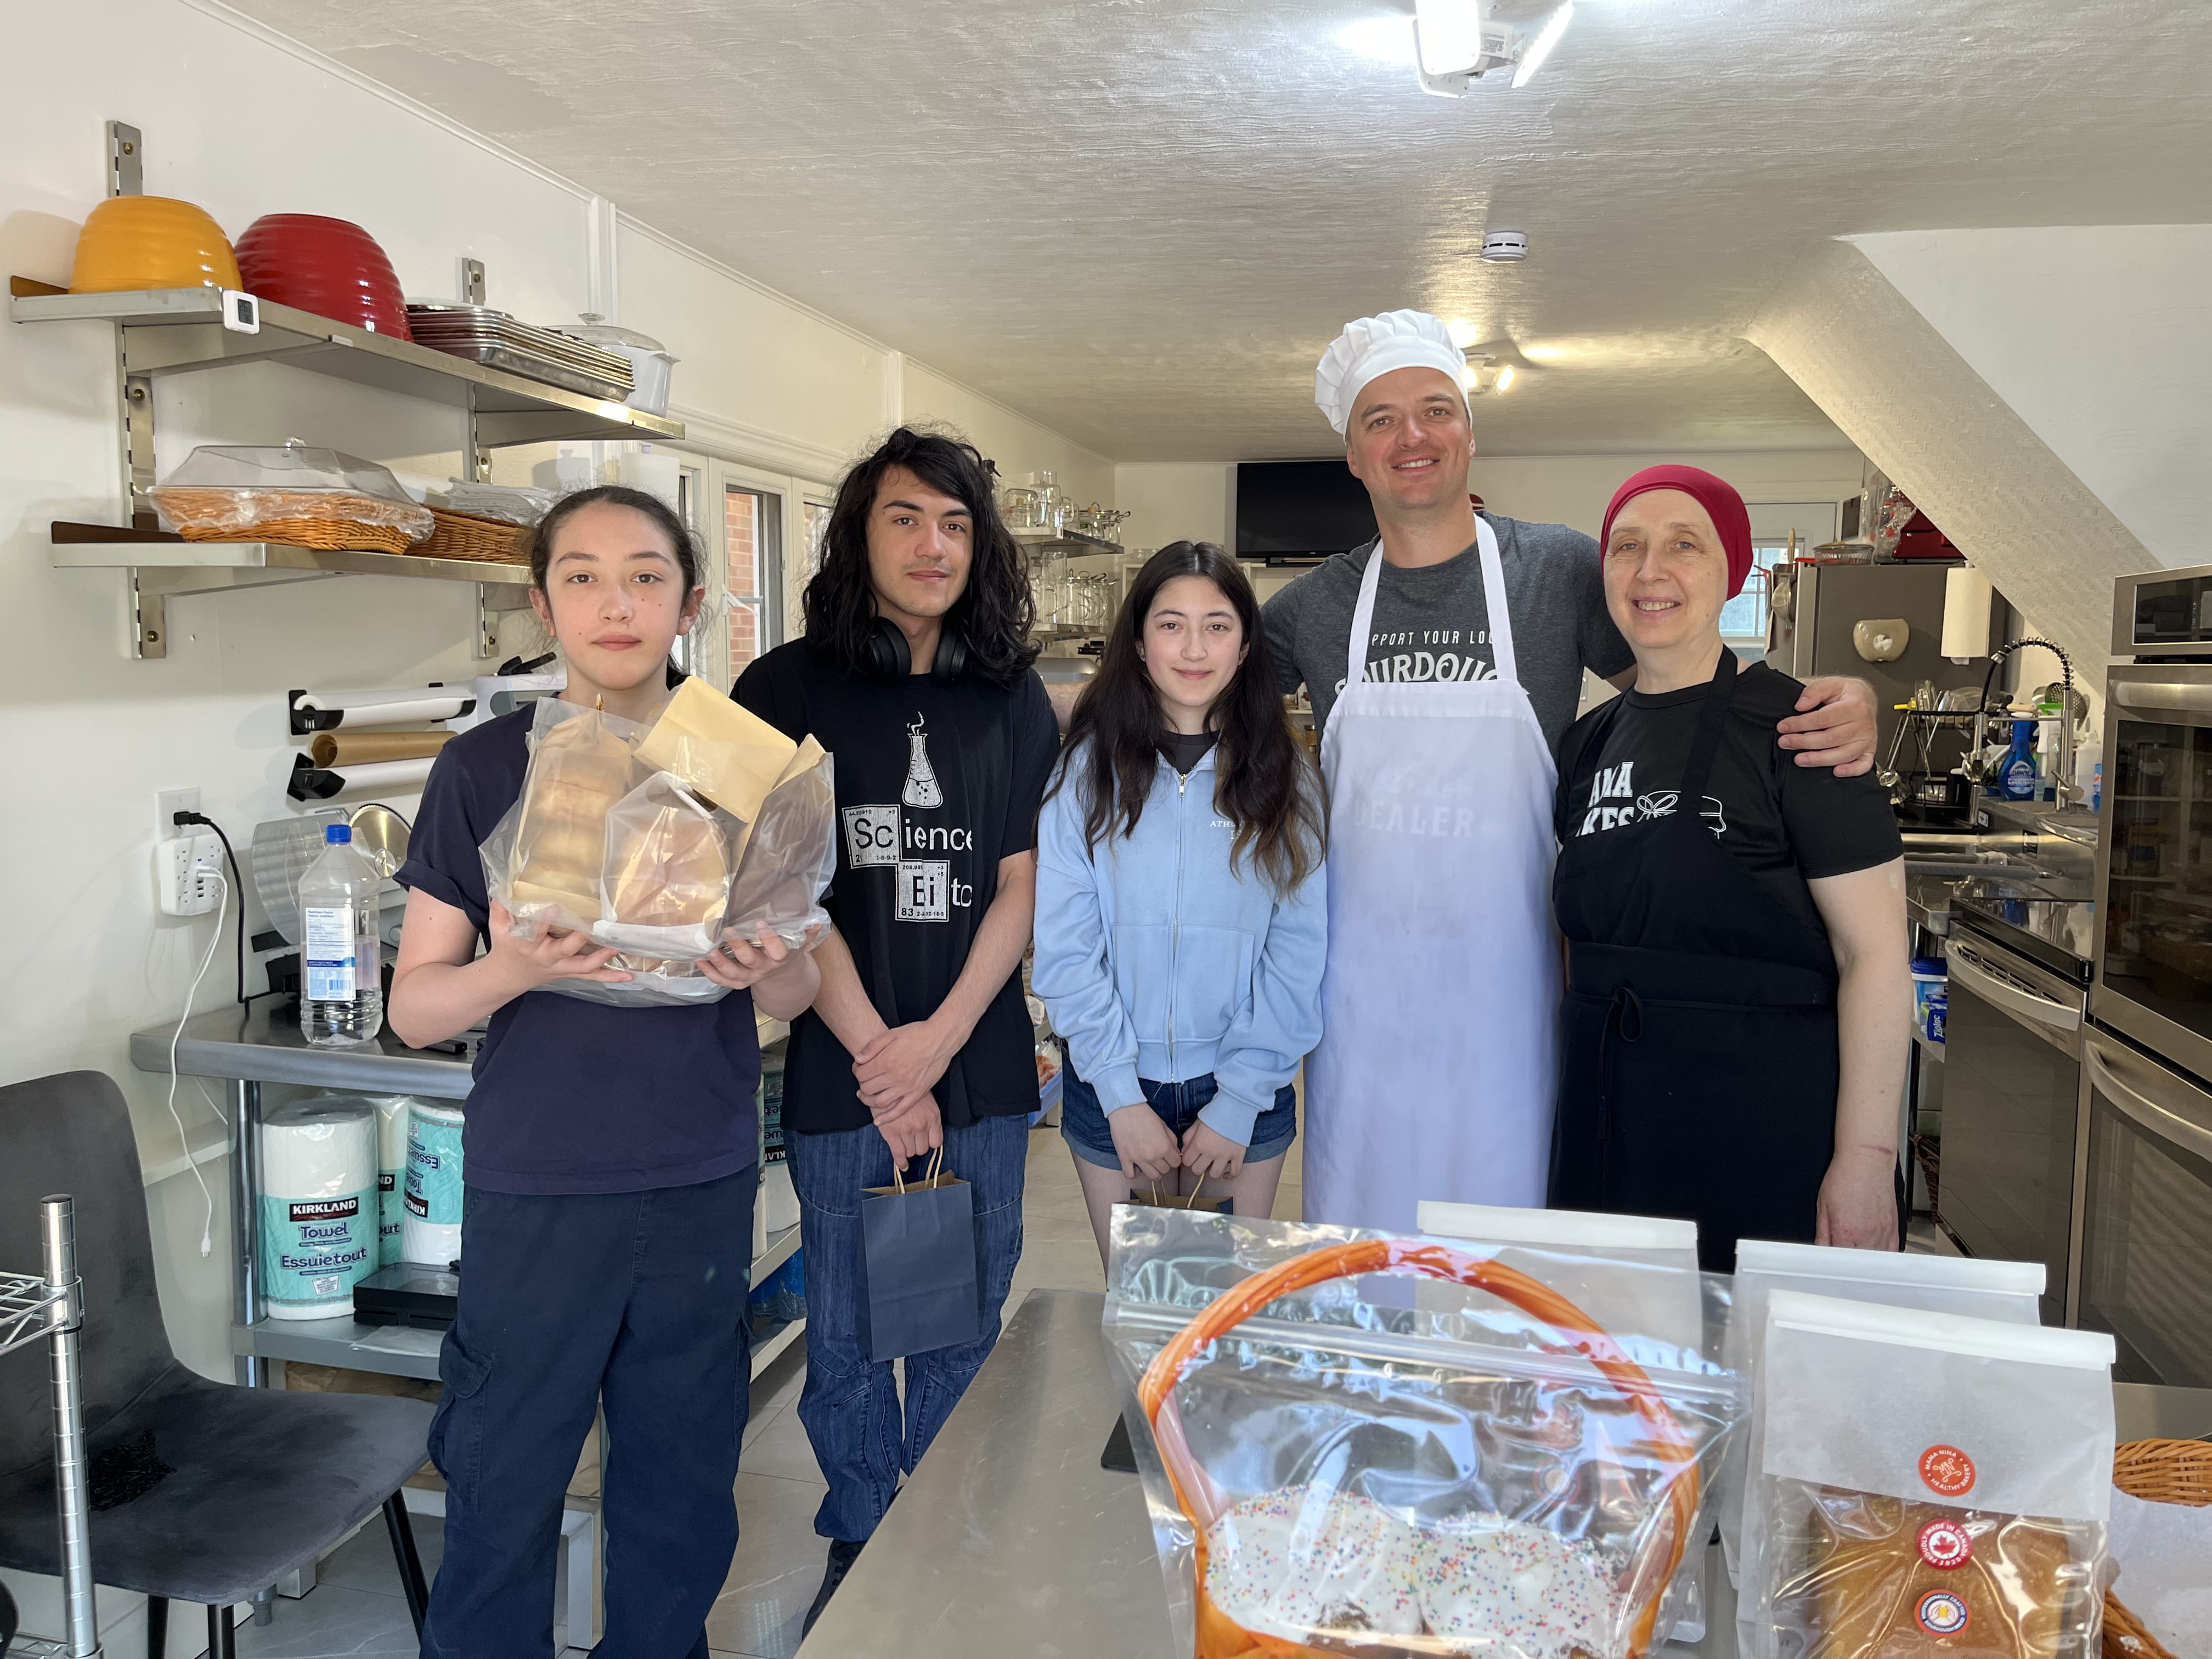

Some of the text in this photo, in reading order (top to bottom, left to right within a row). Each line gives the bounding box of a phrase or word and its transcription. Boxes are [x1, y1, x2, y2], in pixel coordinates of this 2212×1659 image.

[1424, 631, 1460, 644] YOUR
[901, 908, 914, 916] 83
[1933, 1015, 1944, 1038] Ziploc
[293, 1200, 357, 1214] KIRKLAND
[300, 1222, 349, 1239] Towel
[1925, 1452, 1939, 1470] MAMA
[1931, 1464, 1971, 1491] HEALTHY BAKERY
[1926, 1523, 1945, 1535] MADE
[1921, 1535, 1938, 1563] PROUDLY
[1955, 1529, 1968, 1556] CANADA
[1939, 1556, 1962, 1566] 2020
